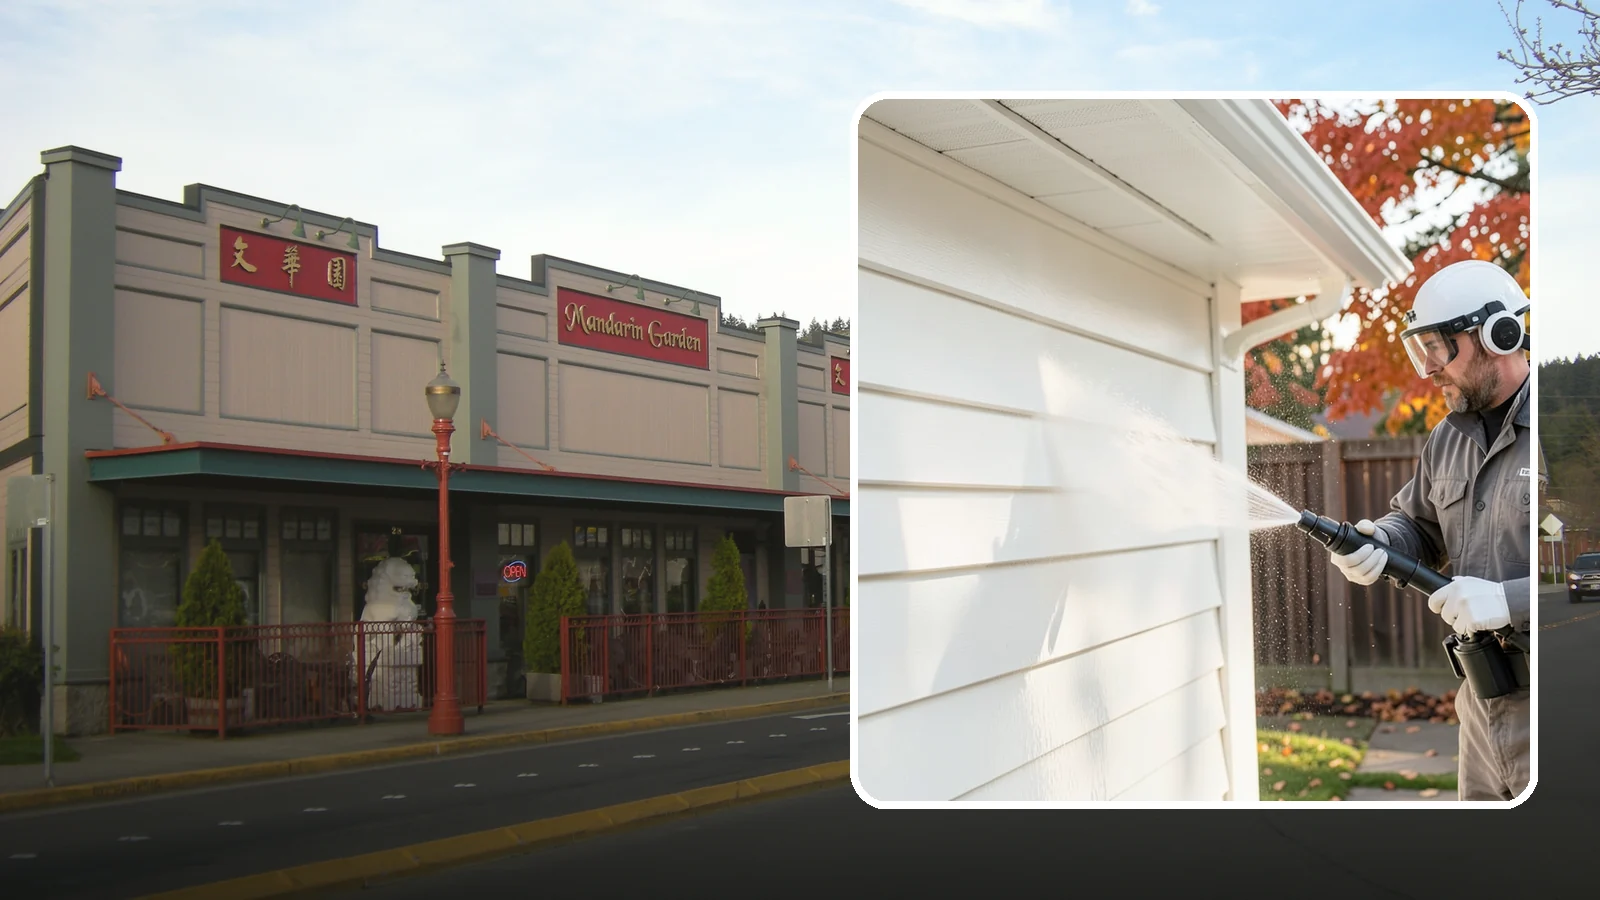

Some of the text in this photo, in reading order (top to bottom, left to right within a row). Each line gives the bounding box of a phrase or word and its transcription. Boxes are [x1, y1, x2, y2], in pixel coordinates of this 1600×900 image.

[231, 236, 346, 291] 文華園
[565, 302, 702, 353] Mandarin Garden
[503, 565, 527, 578] OPEN
